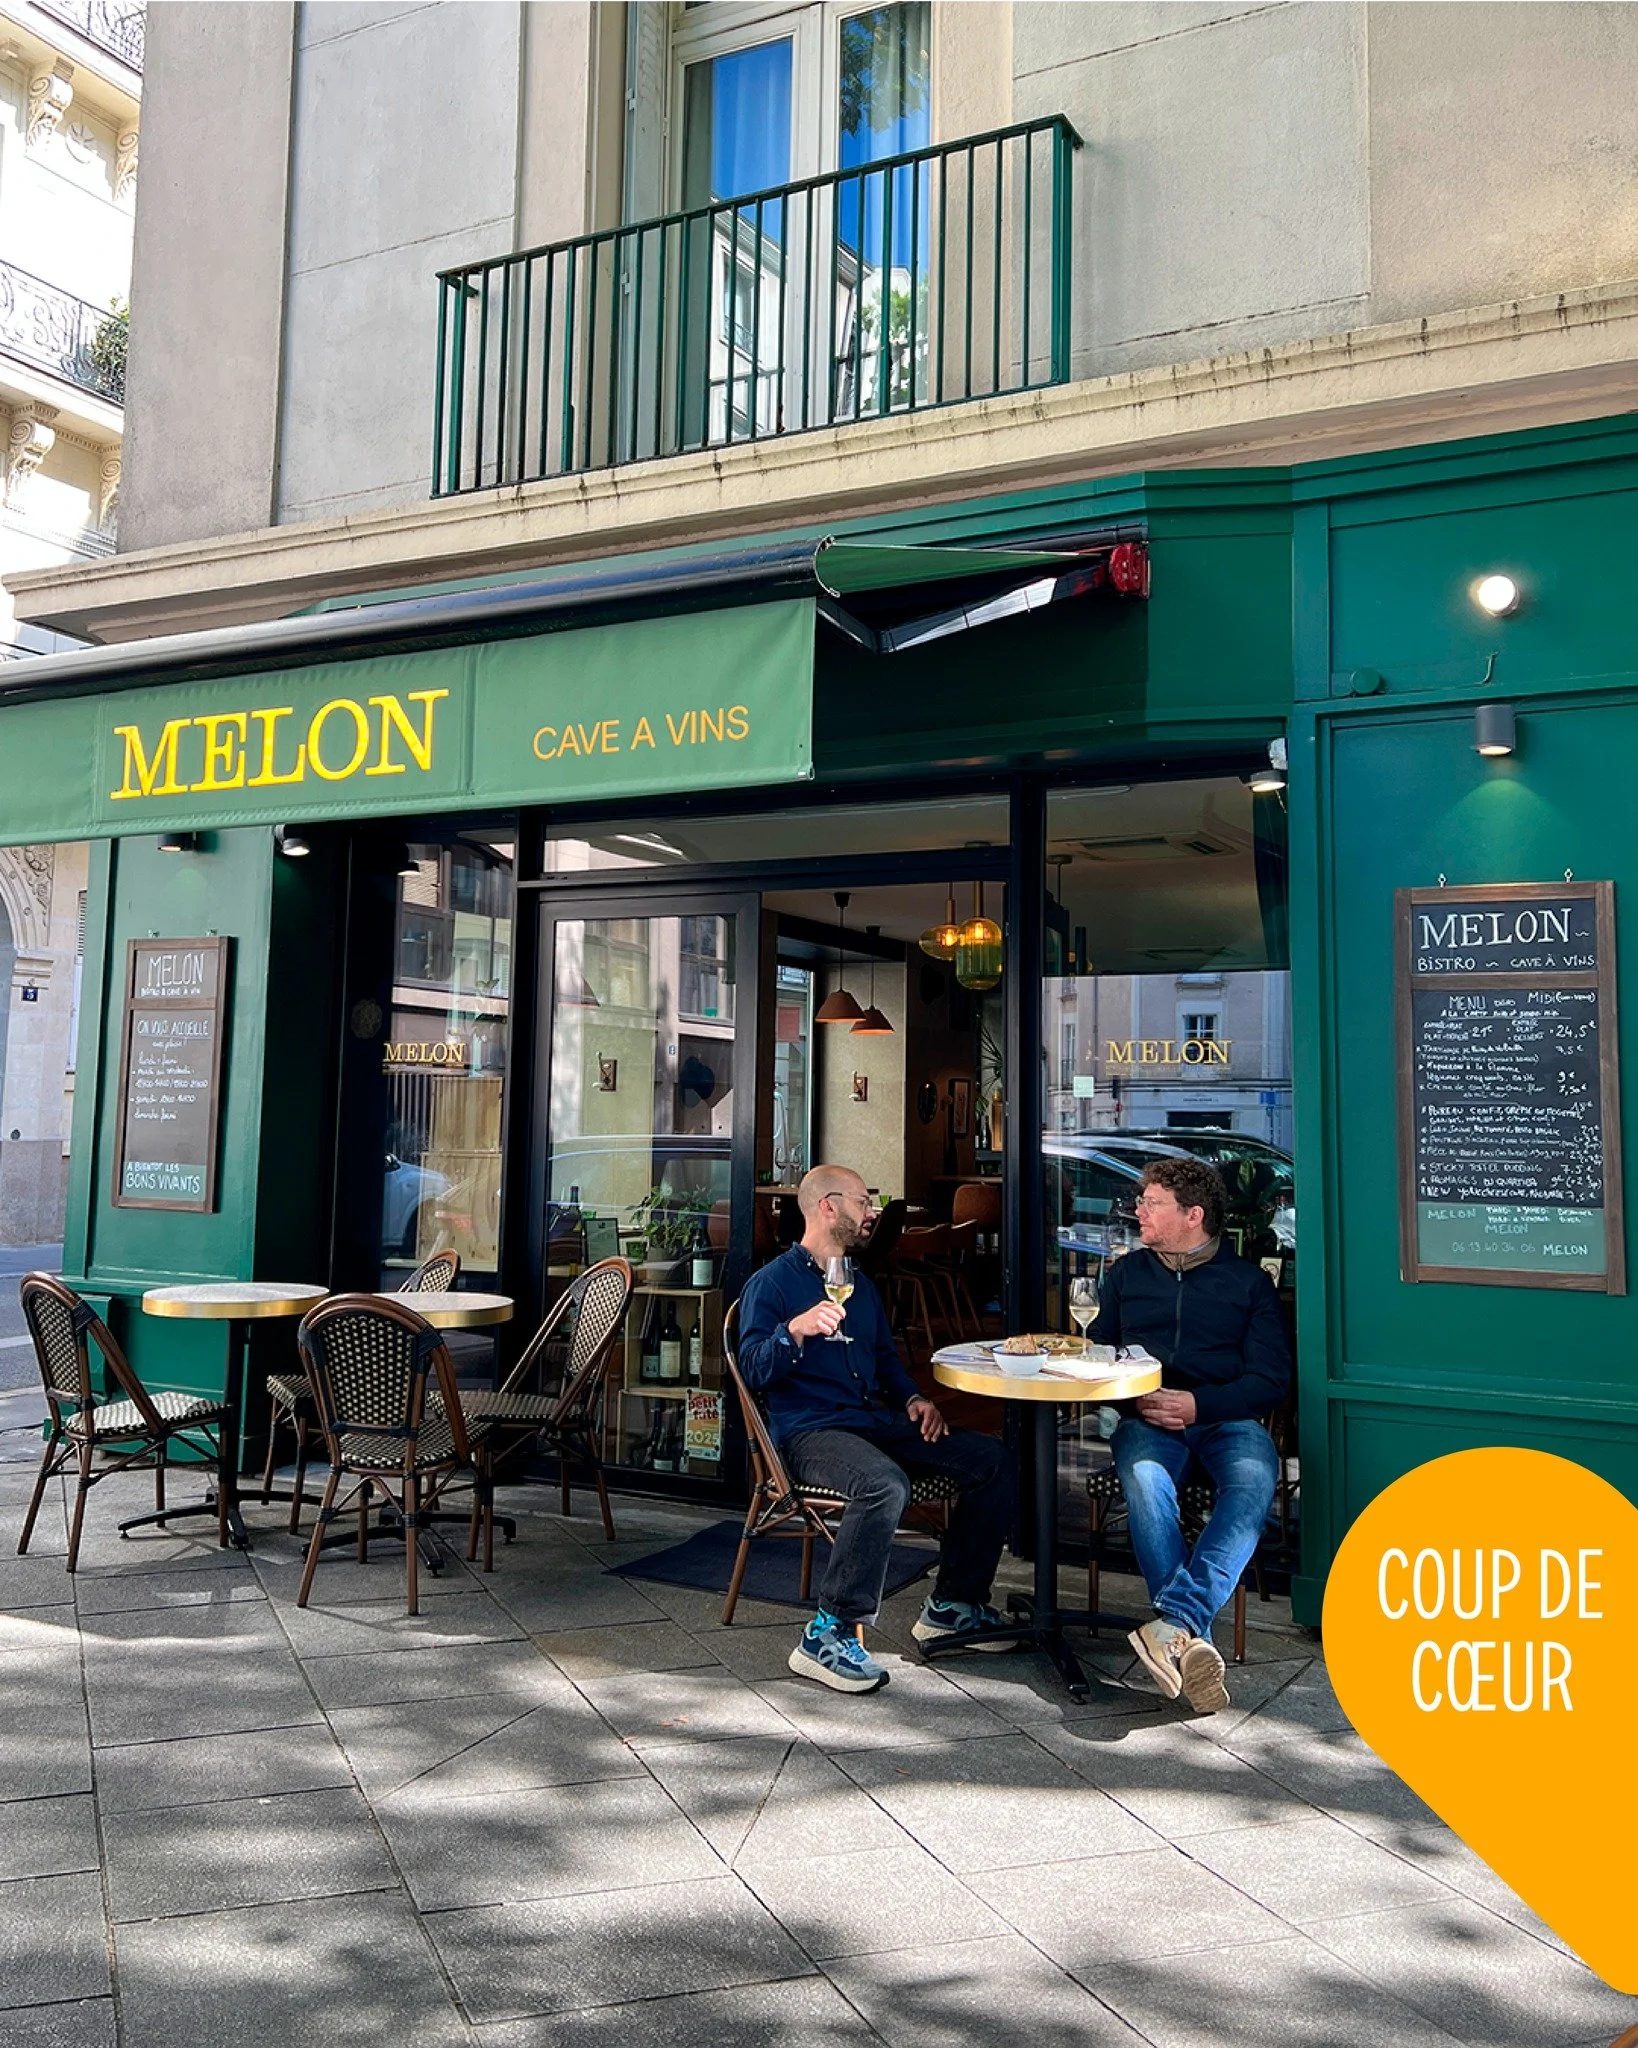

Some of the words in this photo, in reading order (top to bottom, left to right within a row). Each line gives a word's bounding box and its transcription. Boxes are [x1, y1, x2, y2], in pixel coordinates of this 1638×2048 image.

[533, 720, 620, 760] CAVE
[630, 718, 656, 750] A
[666, 705, 750, 746] VINS
[110, 688, 449, 800] MELON
[1418, 907, 1572, 949] MELON
[1510, 957, 1542, 967] CAVE
[147, 953, 204, 988] MELON
[1449, 996, 1486, 1010] MENU
[383, 1042, 466, 1063] MELON
[1106, 1039, 1232, 1065] MELON
[165, 1163, 180, 1174] LES
[1429, 1163, 1465, 1173] STICKY
[125, 1172, 156, 1190] BONS
[158, 1174, 201, 1195] VIVANTS
[1427, 1208, 1476, 1220] MELON
[1484, 1223, 1529, 1235] MELON
[1543, 1244, 1588, 1256] MELON
[688, 1395, 718, 1412] petit
[686, 1430, 720, 1445] 2025
